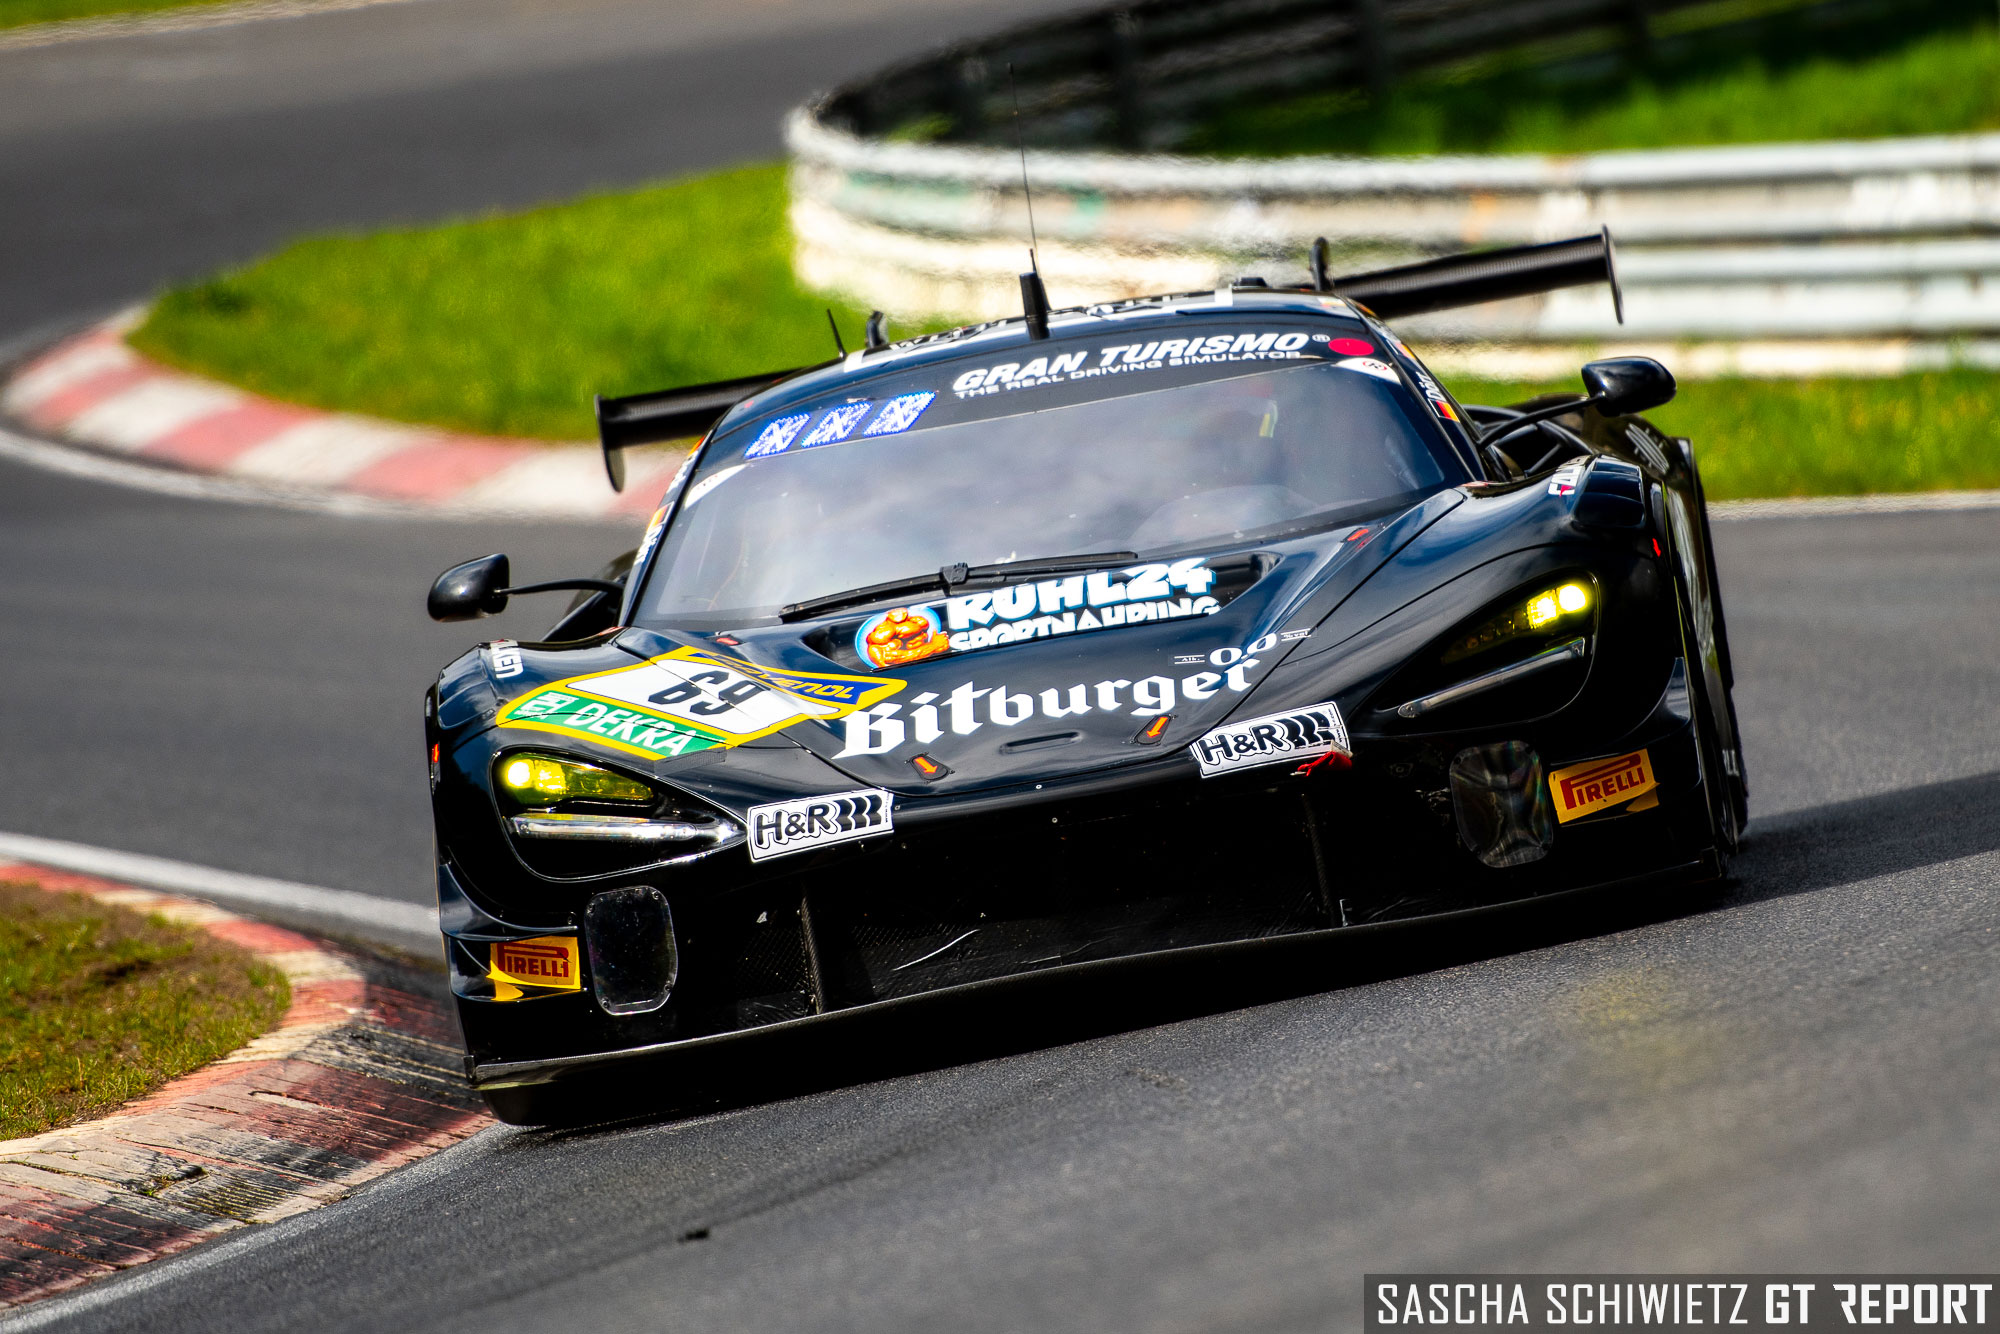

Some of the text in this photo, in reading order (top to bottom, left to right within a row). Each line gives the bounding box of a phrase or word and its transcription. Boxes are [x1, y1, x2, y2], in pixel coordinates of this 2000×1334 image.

[952, 332, 1310, 392] GRAN TURISMO
[953, 350, 1301, 400] THE REAL DRIVING SIMULATOR
[648, 670, 771, 716] 69
[831, 658, 1261, 760] Bitburger
[563, 702, 697, 756] DEKRA
[1196, 722, 1286, 763] H&R
[1560, 753, 1646, 810] PIRELLI
[755, 803, 832, 847] H&R
[497, 942, 569, 978] PIRELLI
